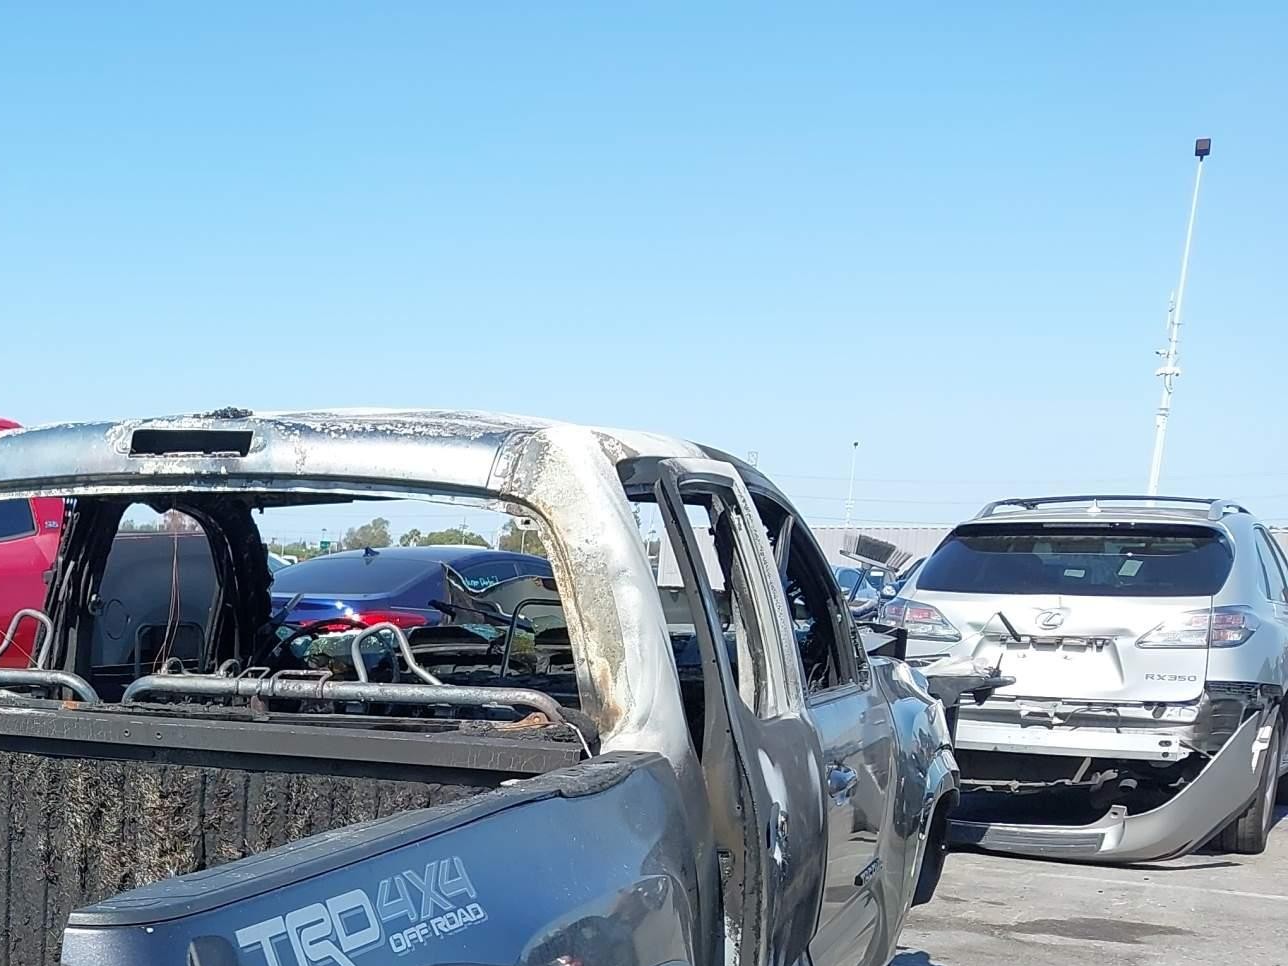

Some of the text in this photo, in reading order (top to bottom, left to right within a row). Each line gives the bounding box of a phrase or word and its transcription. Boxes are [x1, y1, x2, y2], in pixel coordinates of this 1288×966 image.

[376, 856, 478, 921] 4X4
[388, 902, 487, 954] OFF ROAD
